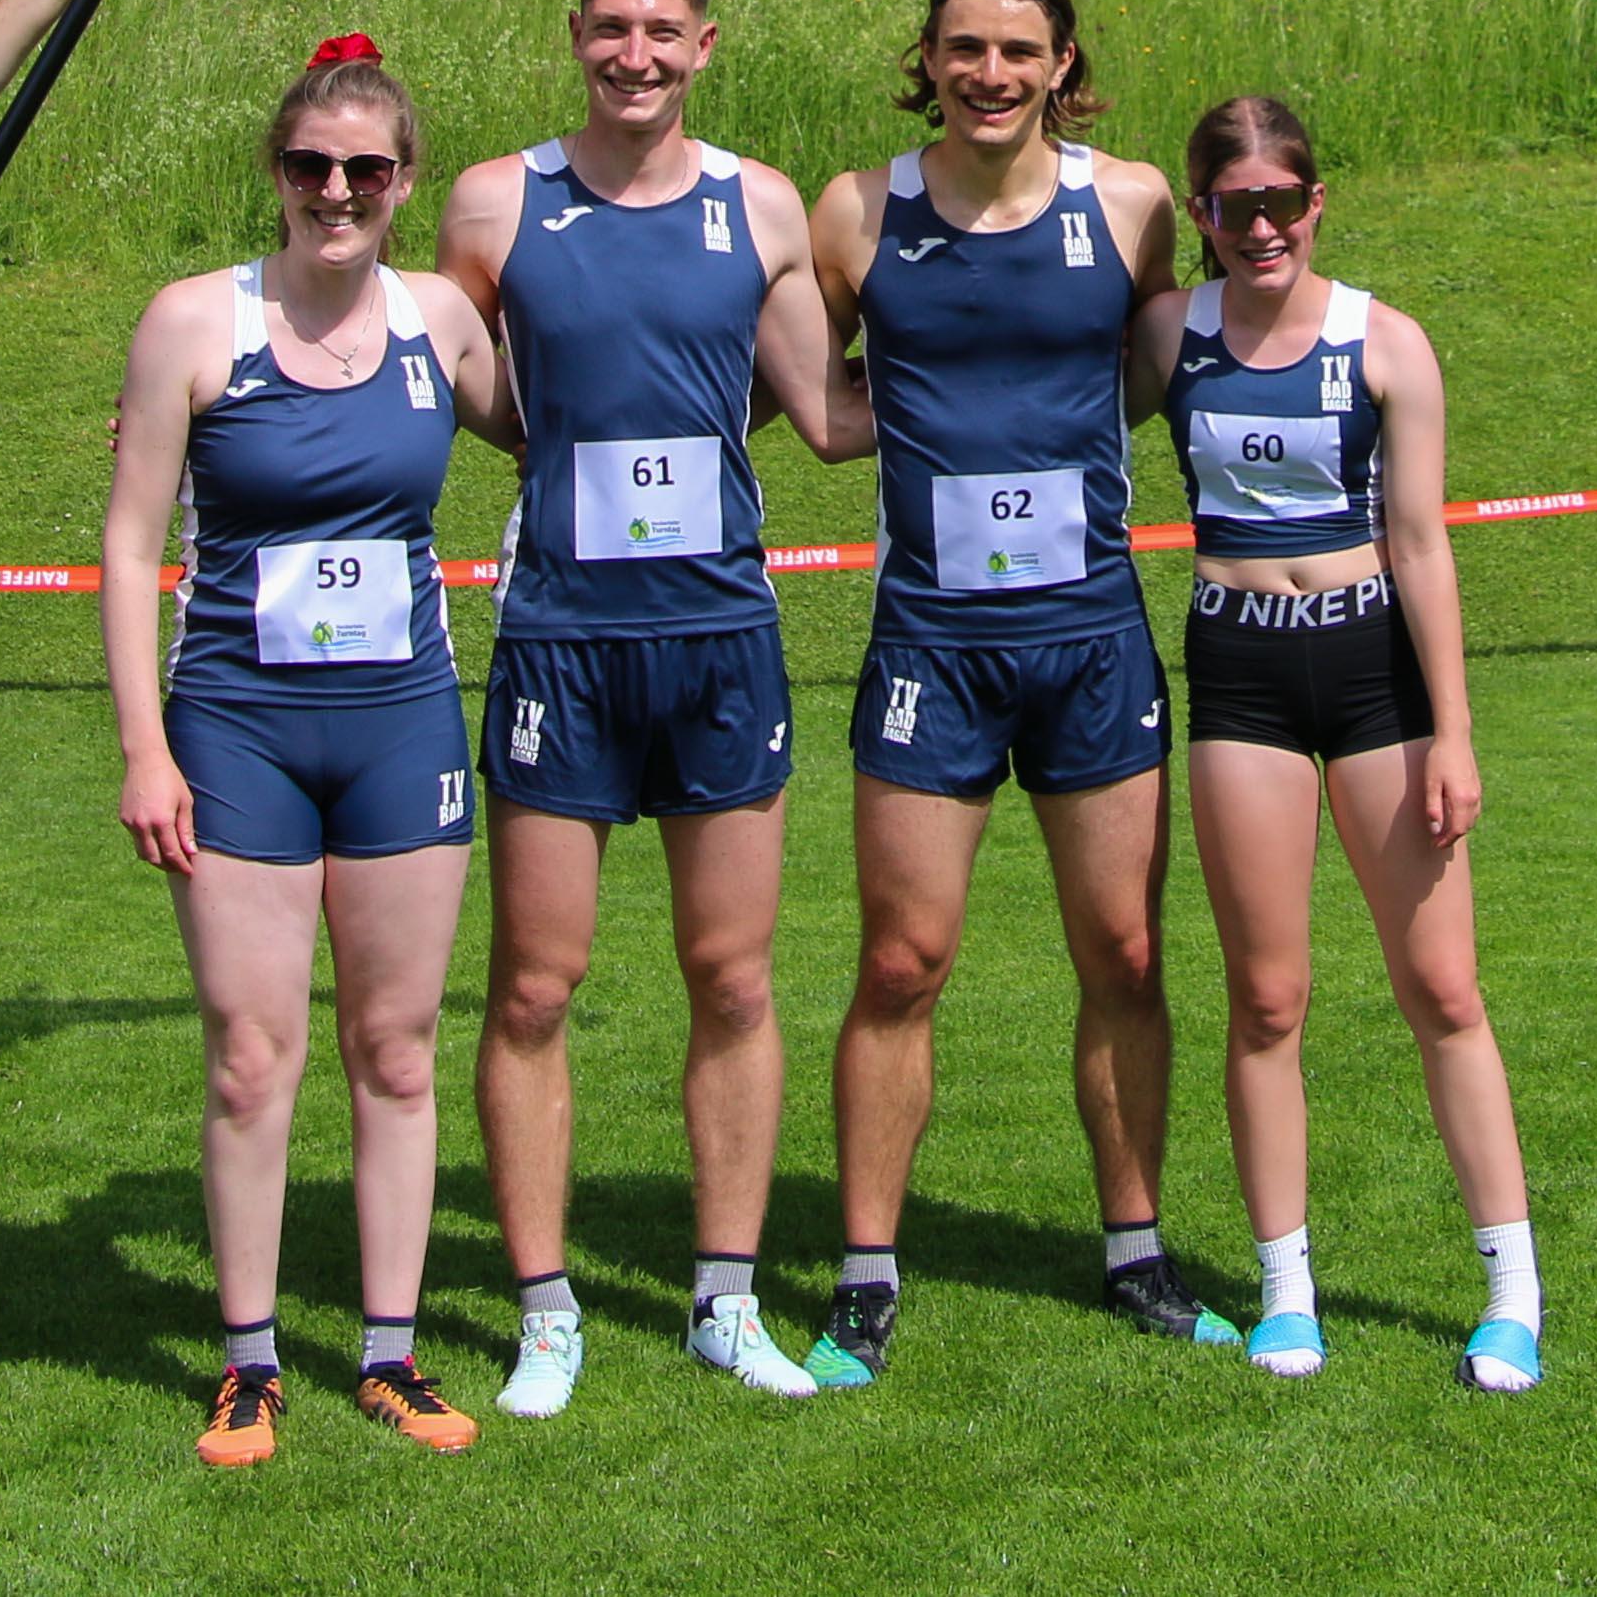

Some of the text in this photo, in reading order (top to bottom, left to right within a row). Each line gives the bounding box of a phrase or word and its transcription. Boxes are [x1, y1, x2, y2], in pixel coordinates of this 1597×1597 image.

[1060, 212, 1088, 238] TV
[400, 355, 430, 381] TV
[1321, 355, 1351, 381] TV
[1321, 381, 1352, 400] BAD
[1241, 433, 1284, 463] 60
[632, 455, 675, 488] 61
[990, 489, 1035, 521] 62
[1476, 493, 1586, 516] RAIFFEISEN
[317, 557, 361, 590] 59
[1238, 588, 1346, 628] NIKE
[889, 676, 922, 711] TV
[517, 696, 546, 732] TV
[511, 725, 541, 752] BAD
[439, 769, 465, 805] TV
